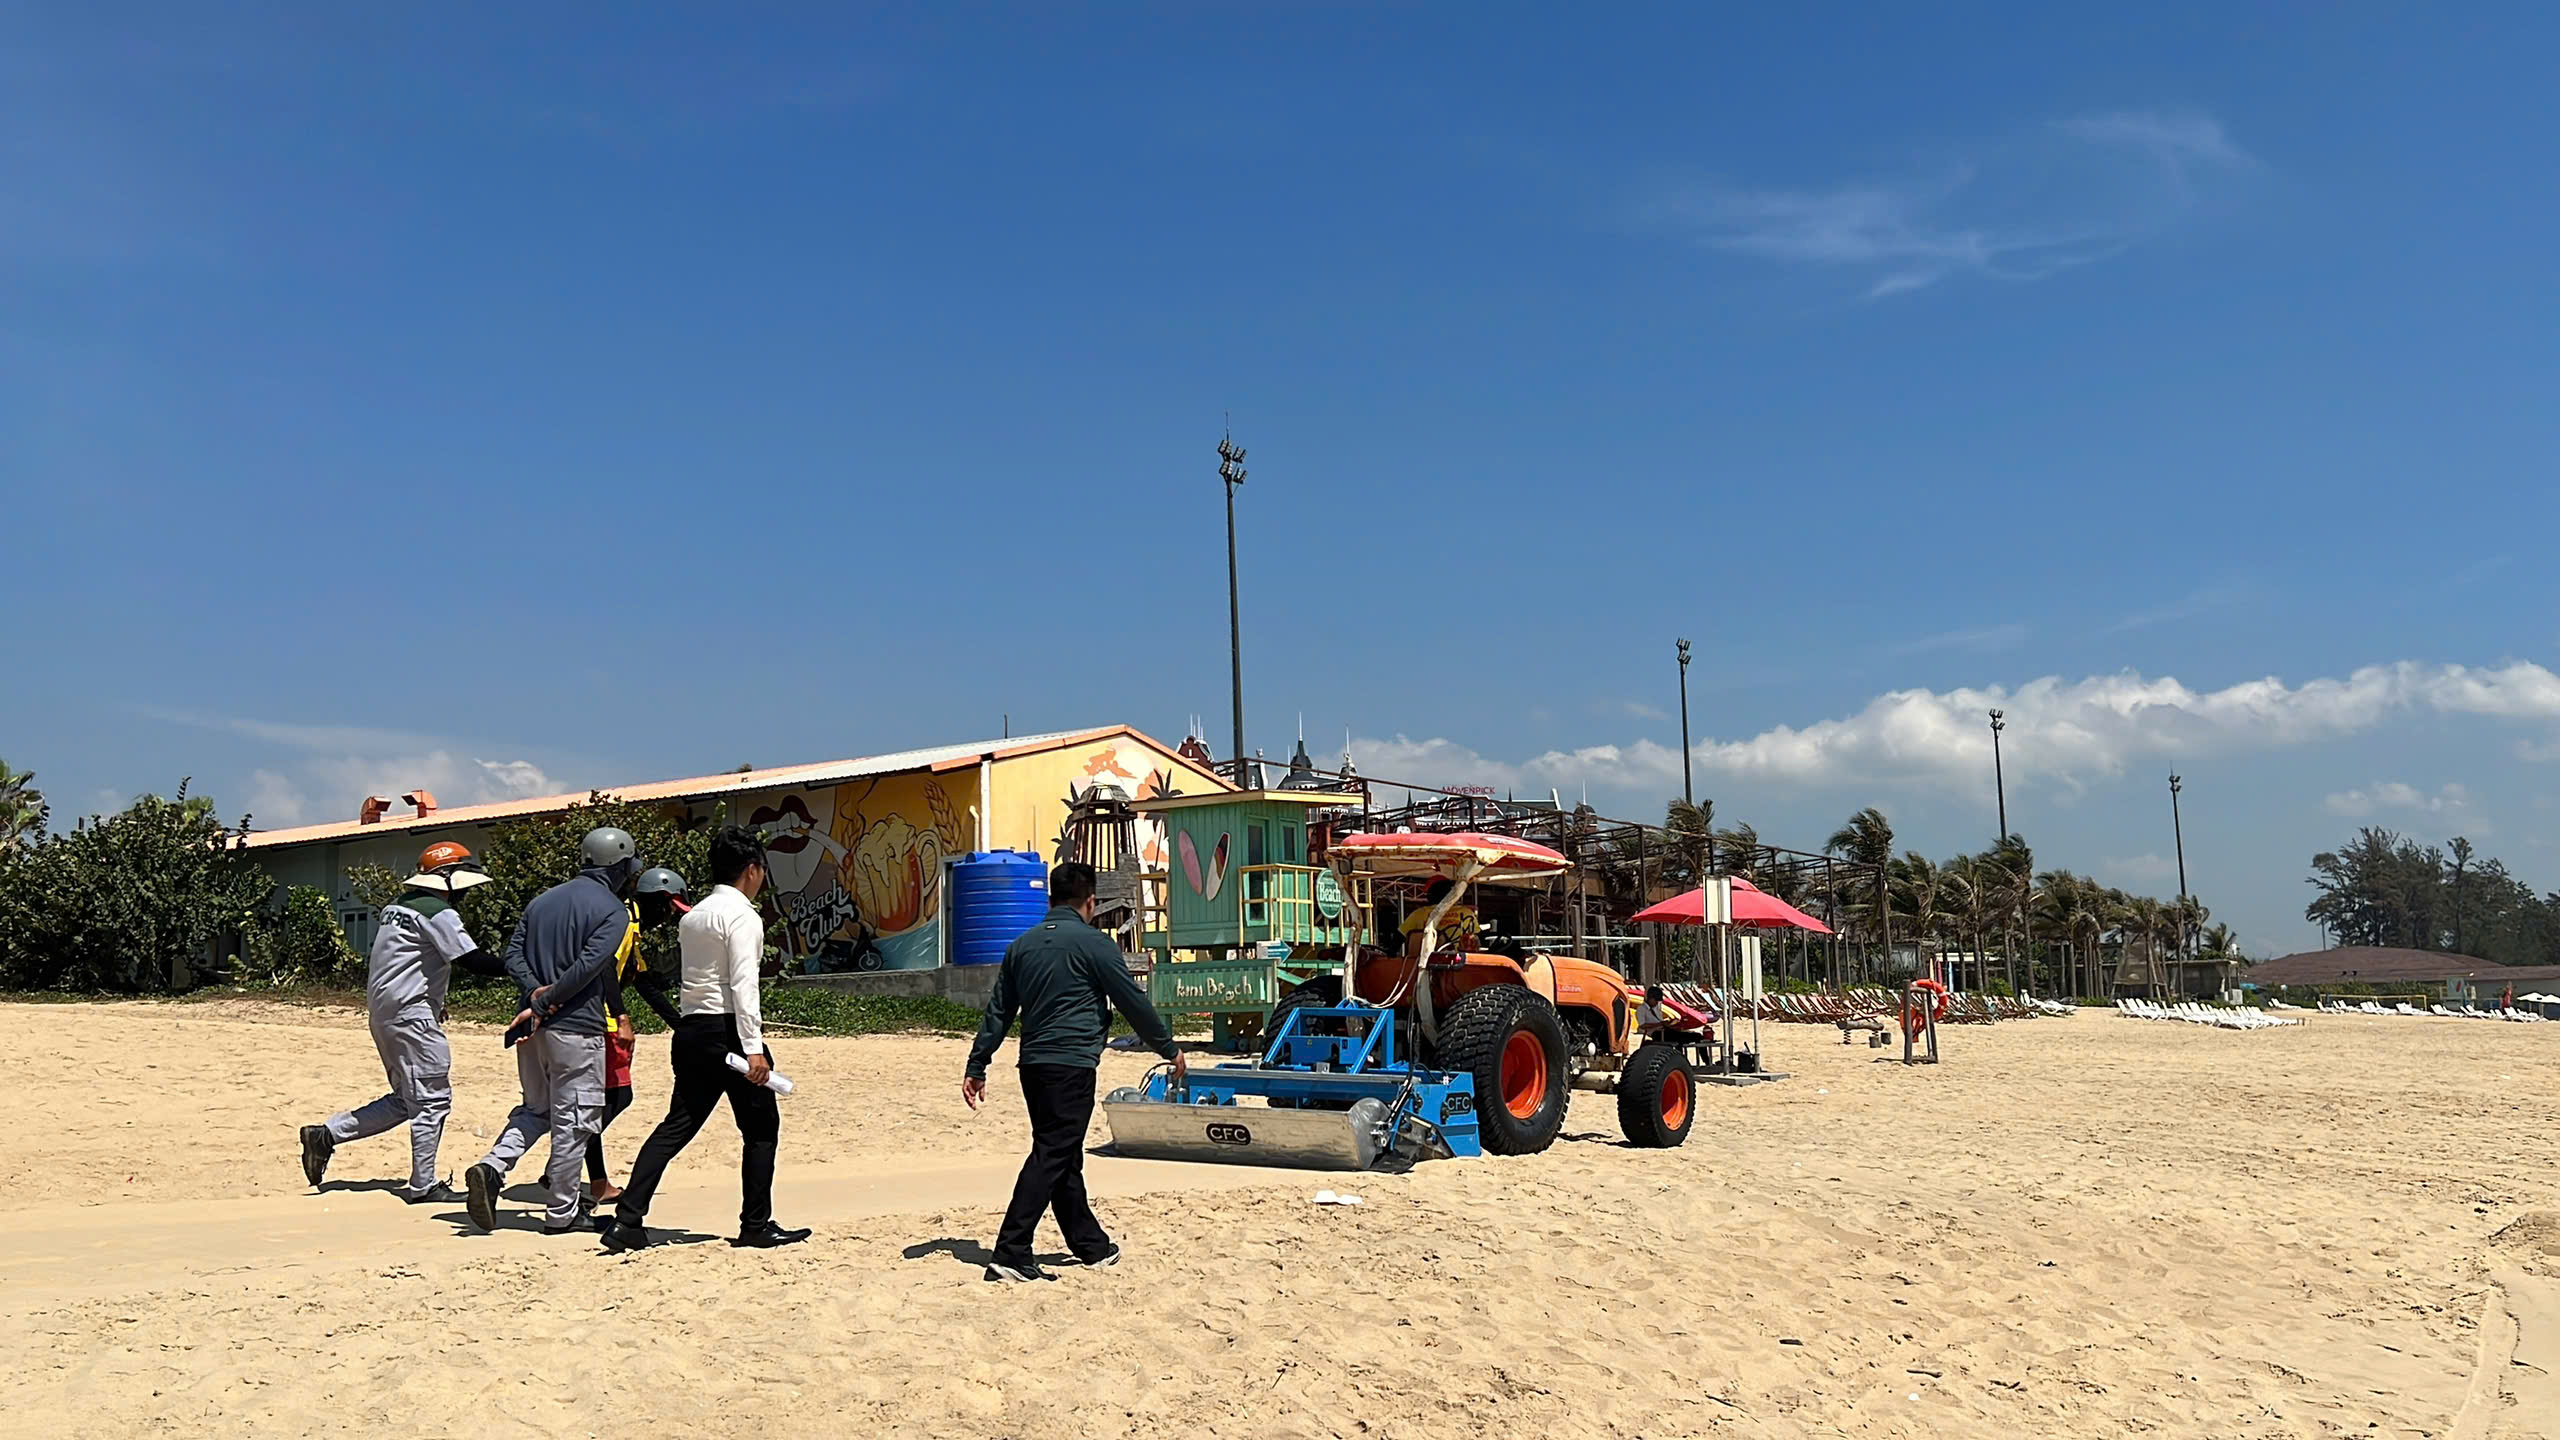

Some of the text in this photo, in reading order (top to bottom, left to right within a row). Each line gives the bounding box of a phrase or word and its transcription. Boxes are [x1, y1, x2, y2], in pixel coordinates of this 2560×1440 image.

[791, 879, 850, 922] Beach
[1320, 882, 1341, 902] Beach
[800, 904, 854, 948] Club
[1206, 975, 1253, 1001] Beach
[1448, 1097, 1470, 1110] CFC
[1210, 1127, 1247, 1141] CFC
